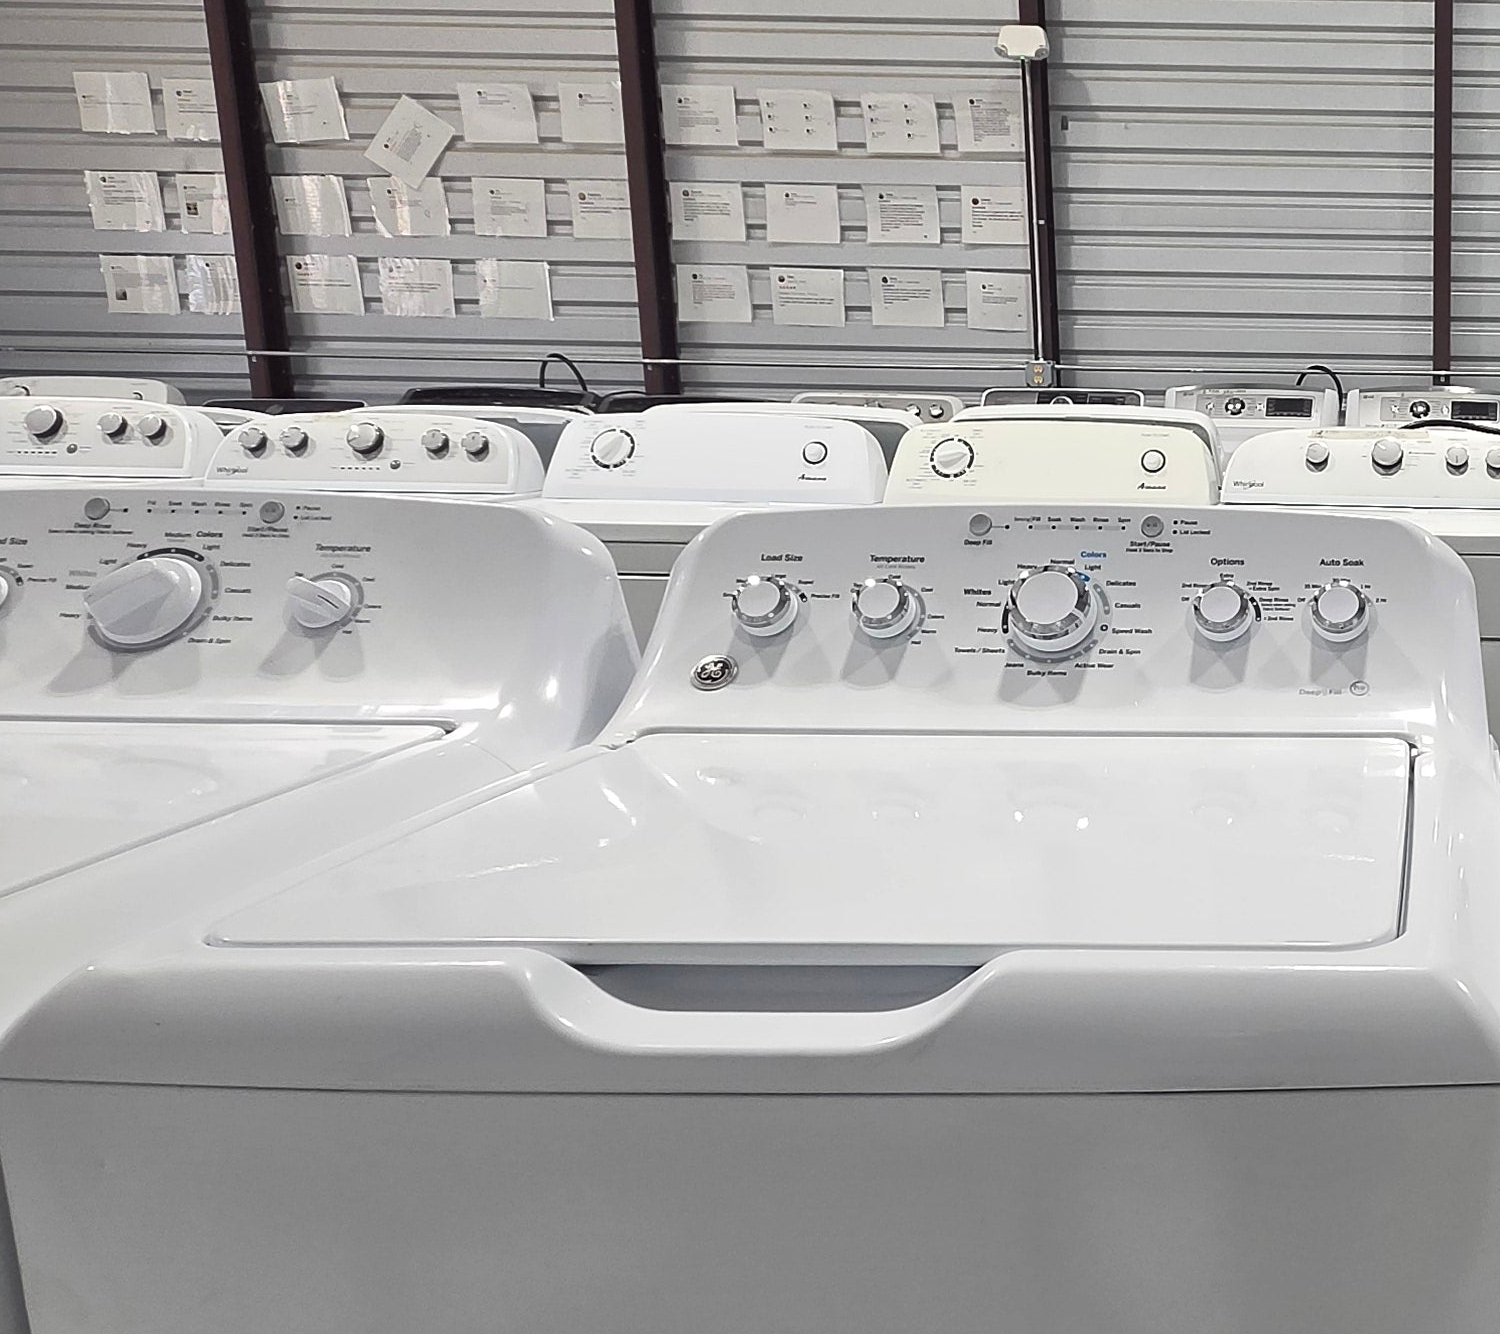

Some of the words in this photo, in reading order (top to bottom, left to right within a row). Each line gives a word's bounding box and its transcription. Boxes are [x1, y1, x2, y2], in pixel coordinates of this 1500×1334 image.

[1137, 482, 1167, 490] Amana
[1233, 480, 1264, 490] Whirlpool
[9, 537, 28, 545] Size
[761, 553, 782, 562] Load
[784, 553, 803, 562] Size
[869, 554, 925, 563] Temperature
[1210, 558, 1245, 566] Options
[1319, 558, 1341, 566] Auto
[1342, 558, 1364, 566] Soak
[1027, 670, 1047, 678] Bulky
